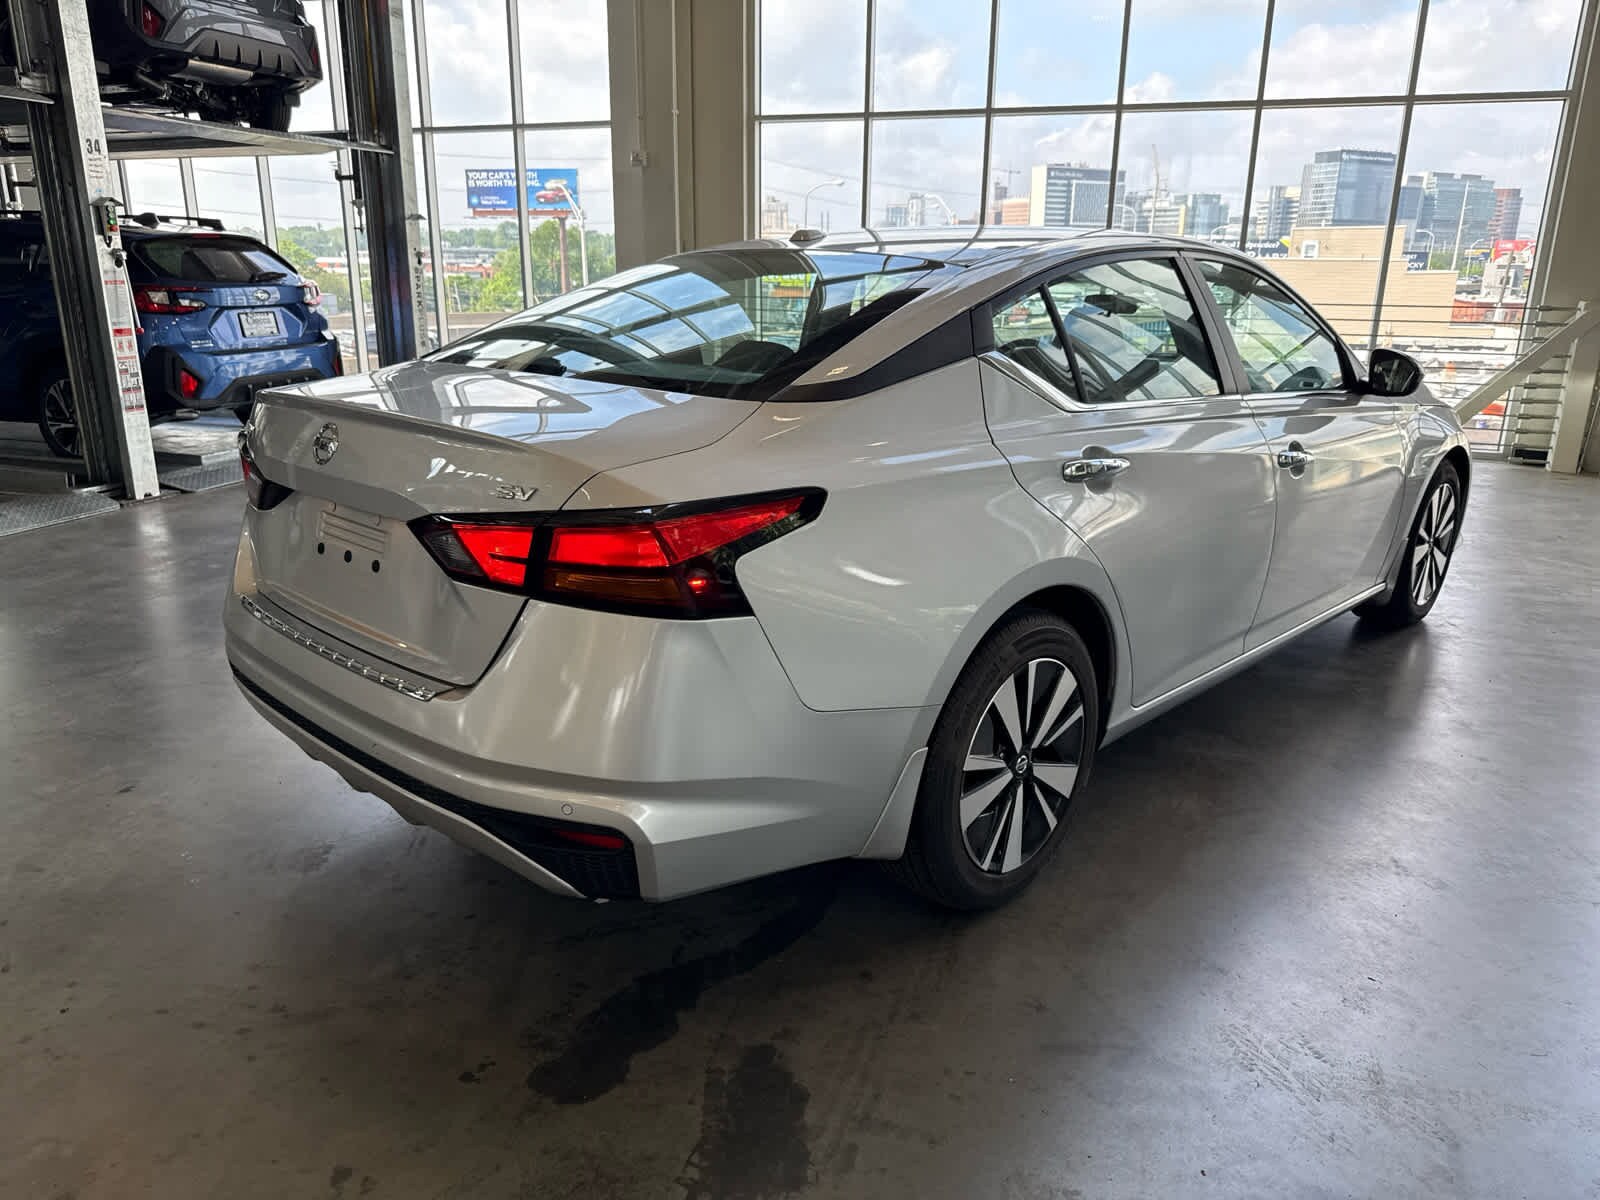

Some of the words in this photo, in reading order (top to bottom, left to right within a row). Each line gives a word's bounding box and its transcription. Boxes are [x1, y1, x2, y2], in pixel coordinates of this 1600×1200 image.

[86, 138, 101, 155] 34
[468, 172, 488, 180] YOUR
[475, 180, 503, 188] WORTH
[496, 484, 538, 502] SV
